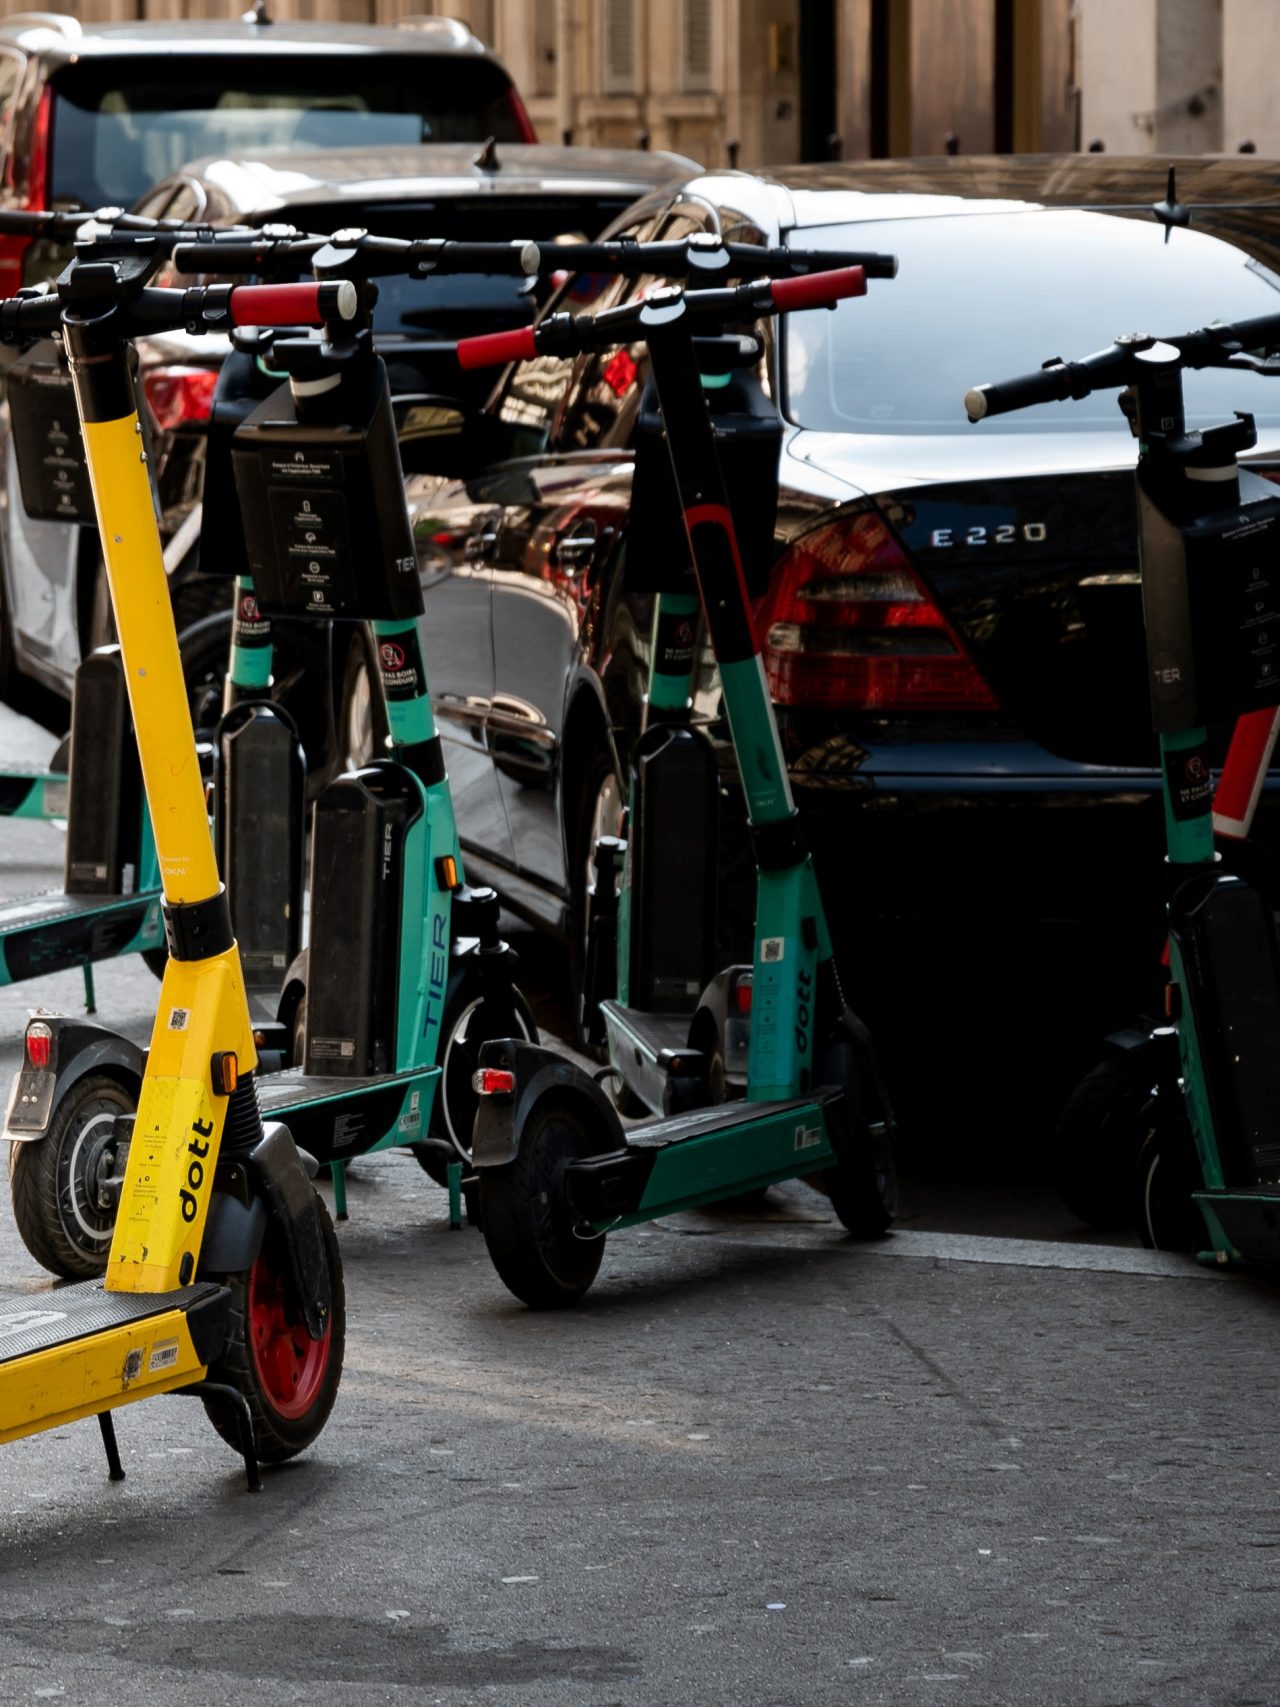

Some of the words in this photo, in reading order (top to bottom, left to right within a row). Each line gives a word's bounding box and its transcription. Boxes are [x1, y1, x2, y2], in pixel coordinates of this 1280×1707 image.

[932, 529, 953, 547] E
[967, 523, 1047, 545] 220
[396, 556, 415, 572] TIER
[1155, 668, 1181, 684] TIER
[383, 823, 393, 880] TIER
[423, 913, 447, 1038] TIER
[795, 969, 812, 1054] dott
[179, 1117, 214, 1223] dott
